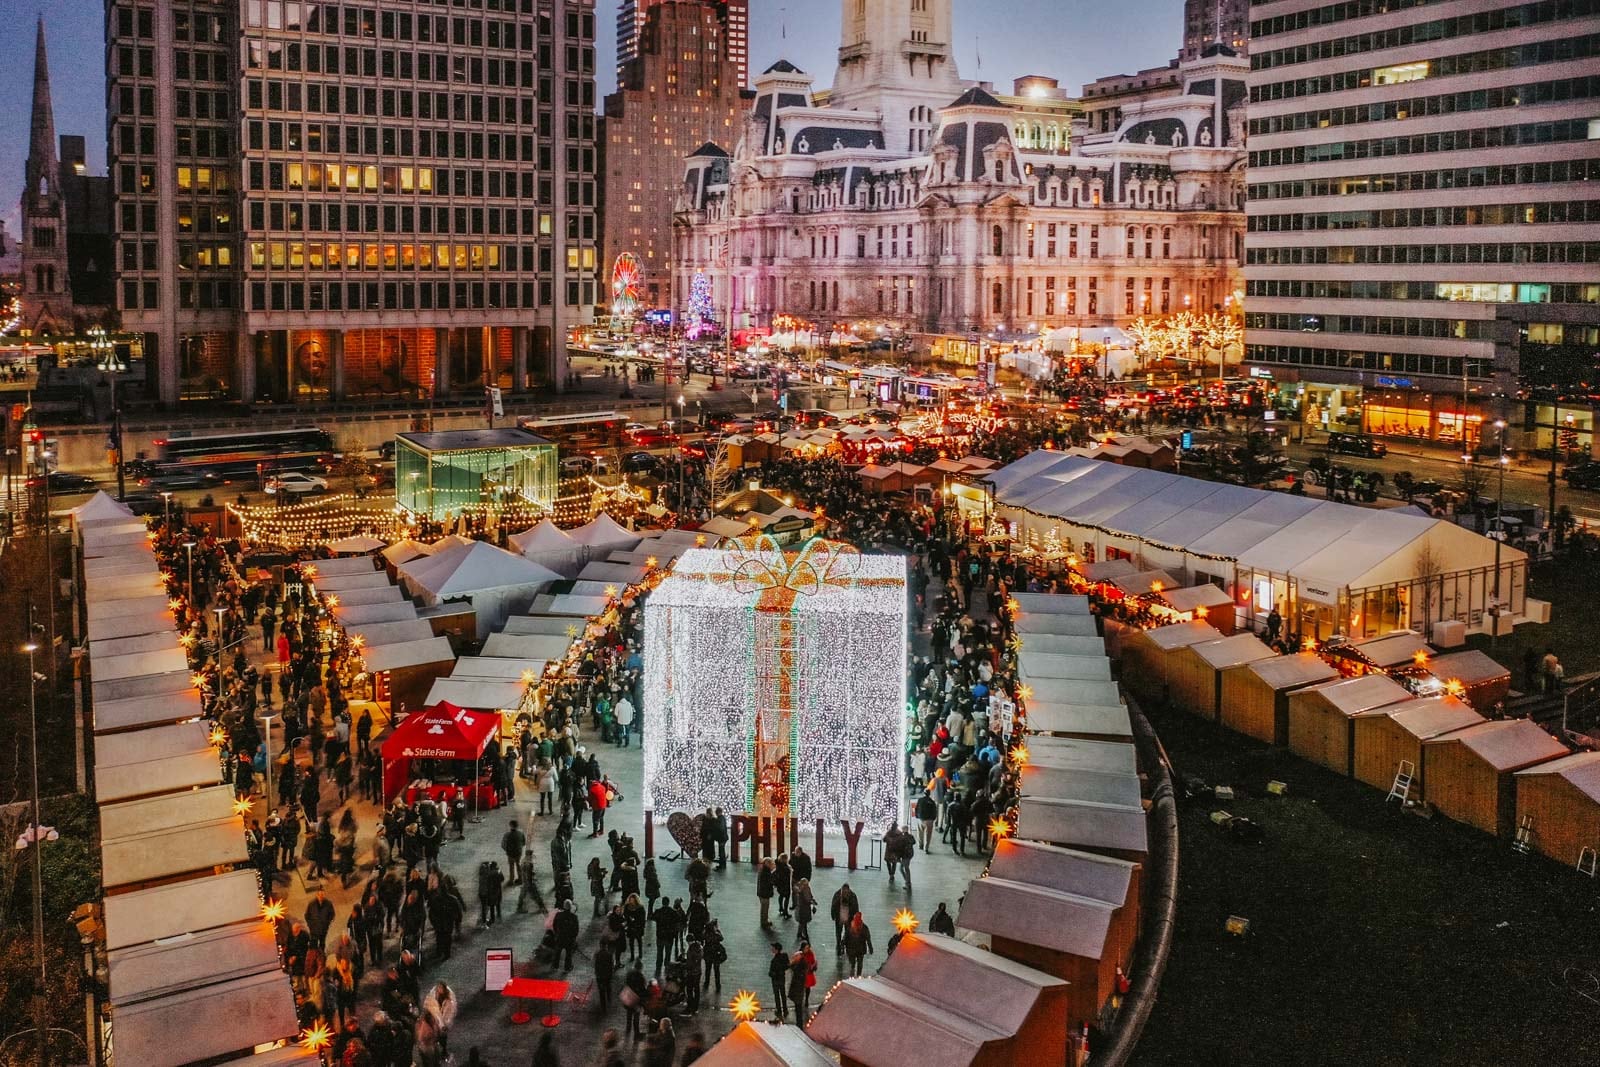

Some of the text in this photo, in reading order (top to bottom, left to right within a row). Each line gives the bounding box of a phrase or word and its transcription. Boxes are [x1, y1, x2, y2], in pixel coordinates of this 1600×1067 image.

[1306, 586, 1329, 597] verizon
[644, 810, 865, 870] I PHILLY
